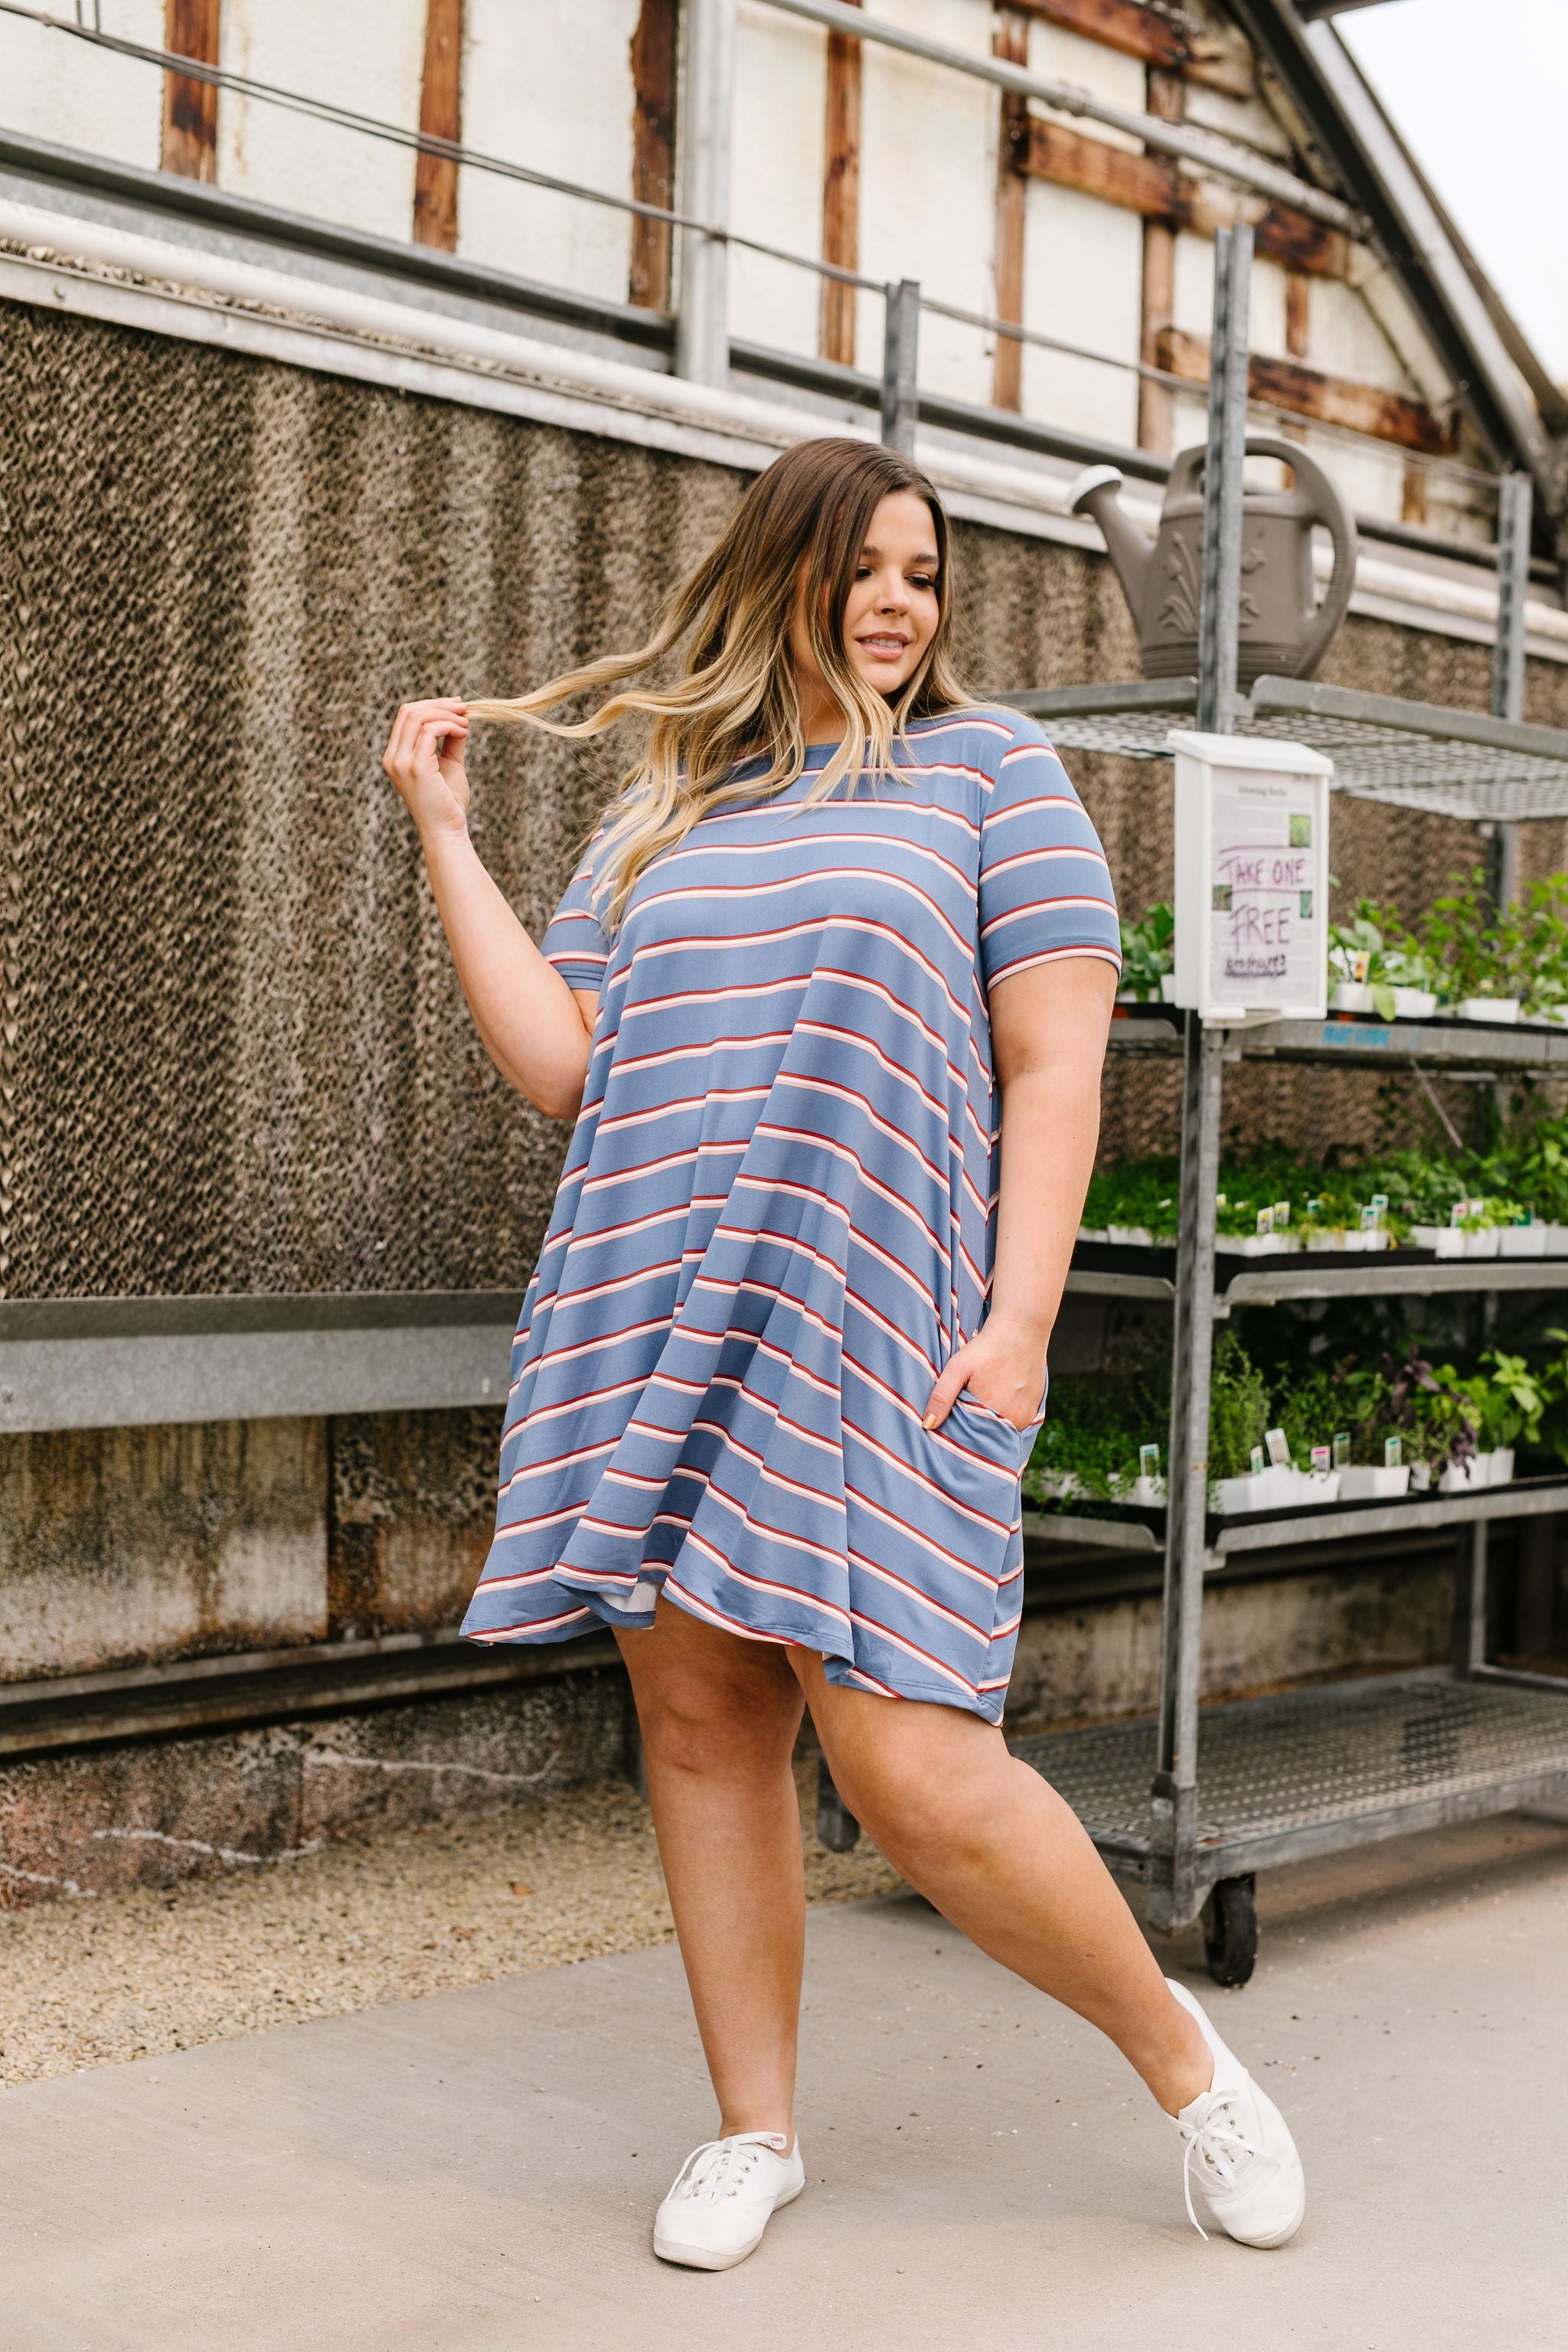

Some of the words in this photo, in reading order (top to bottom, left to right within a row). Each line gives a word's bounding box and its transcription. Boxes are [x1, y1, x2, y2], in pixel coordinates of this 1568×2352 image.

[1218, 856, 1264, 885] TAKE
[1272, 858, 1305, 885] ONE
[1228, 903, 1291, 954] FREE
